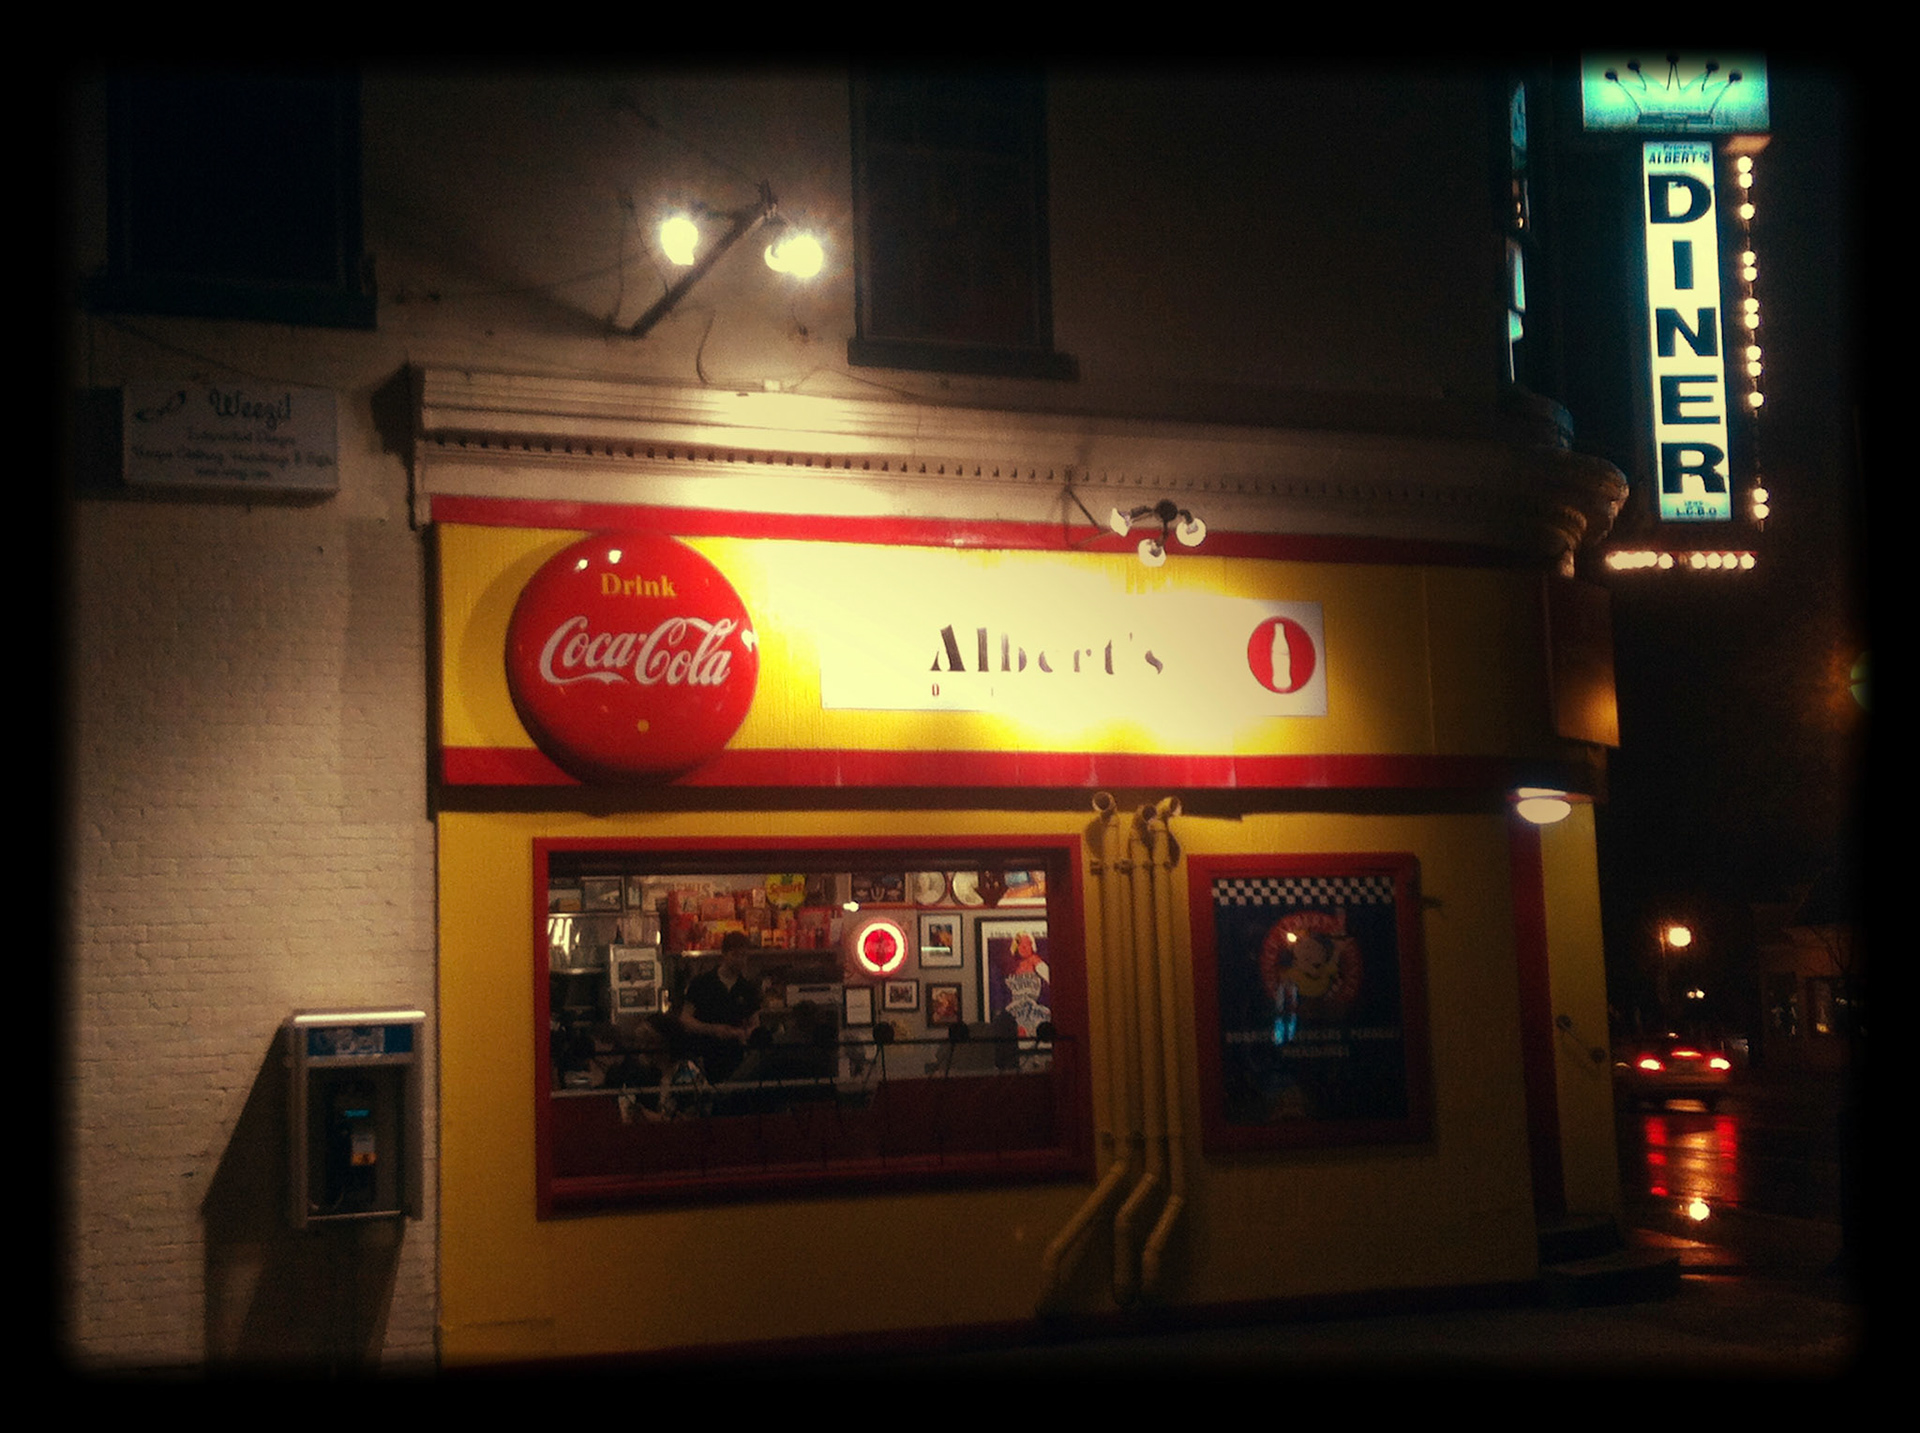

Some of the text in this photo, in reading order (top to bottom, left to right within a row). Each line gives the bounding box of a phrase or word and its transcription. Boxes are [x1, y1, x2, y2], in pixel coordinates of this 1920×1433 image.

[1648, 151, 1710, 164] ALBERT'S
[1648, 174, 1728, 494] DINER
[600, 573, 677, 598] Drink
[539, 616, 739, 686] Coca-Cola
[929, 624, 1164, 675] Albert's
